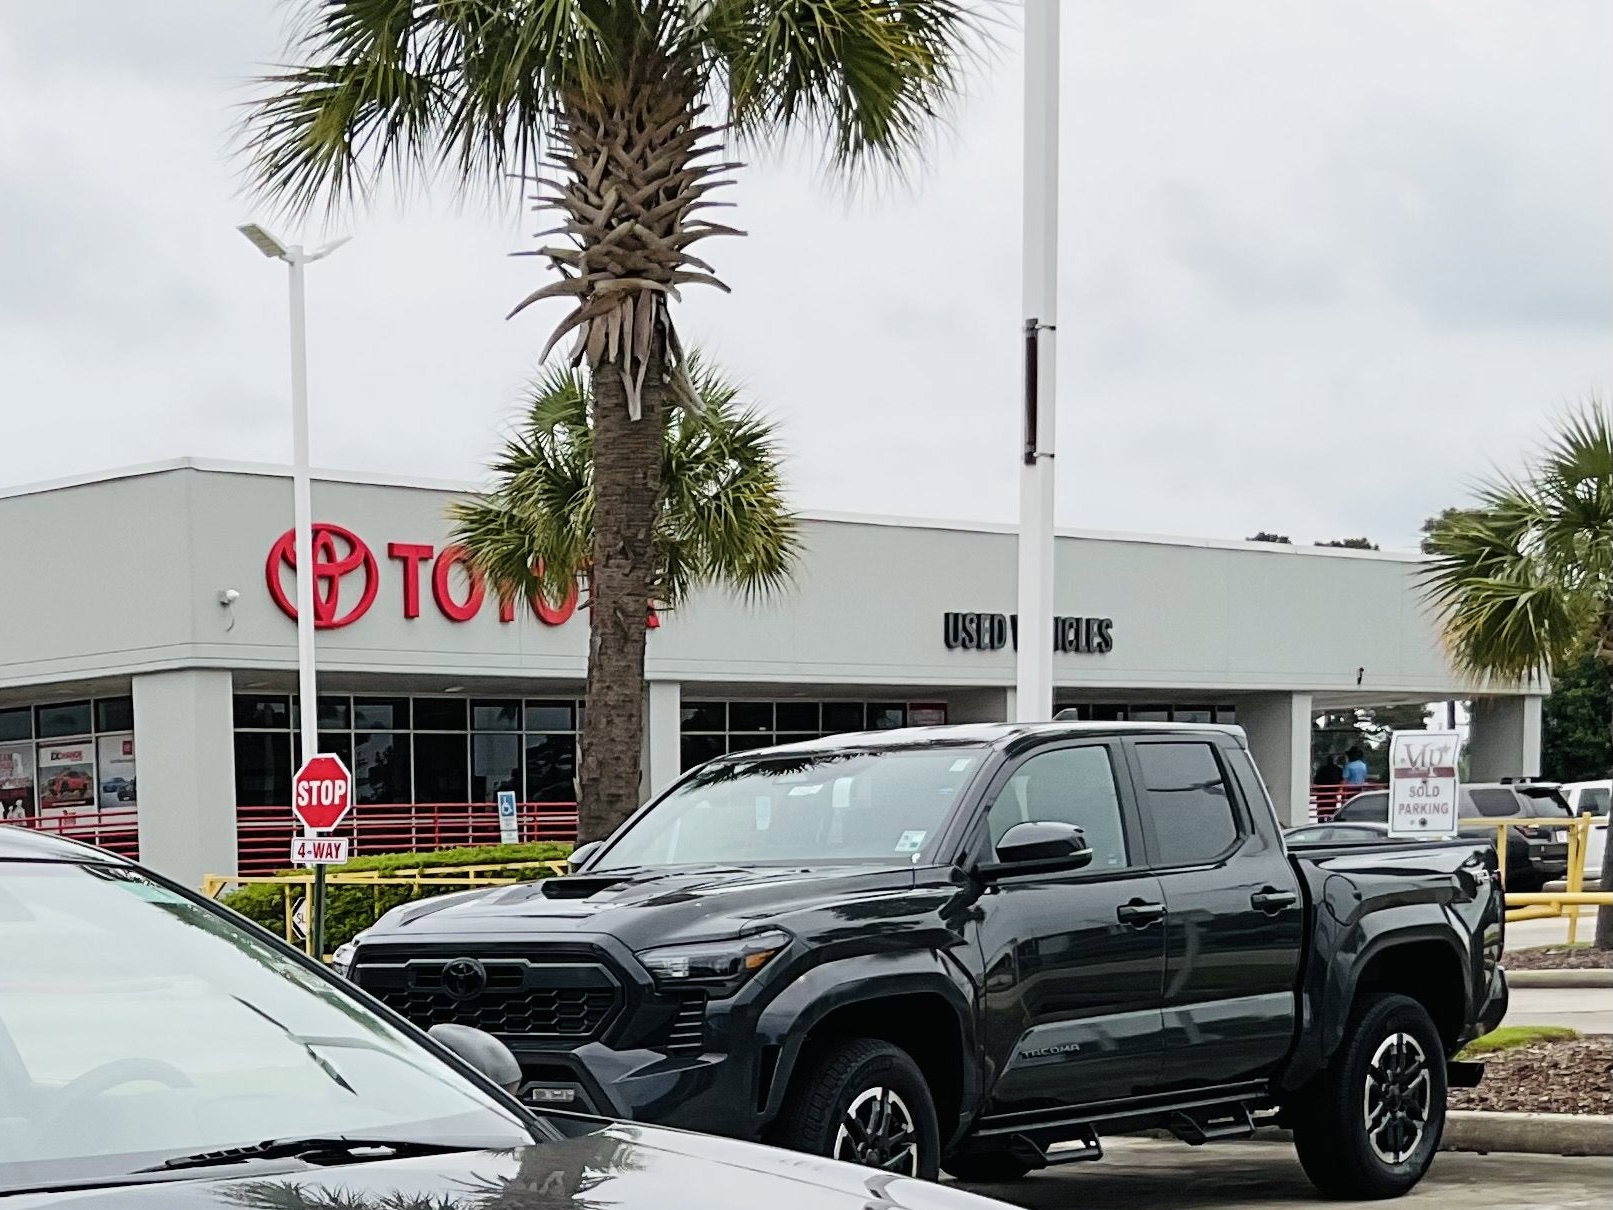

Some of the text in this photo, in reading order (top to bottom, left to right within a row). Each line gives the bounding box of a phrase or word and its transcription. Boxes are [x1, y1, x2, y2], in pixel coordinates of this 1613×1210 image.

[944, 612, 1113, 653] USED ICLES
[297, 780, 347, 806] STOP
[1409, 785, 1440, 798] SOLD
[1398, 803, 1450, 815] PARKING
[297, 842, 342, 859] 4-WAY
[1020, 1044, 1080, 1059] TACOMA
